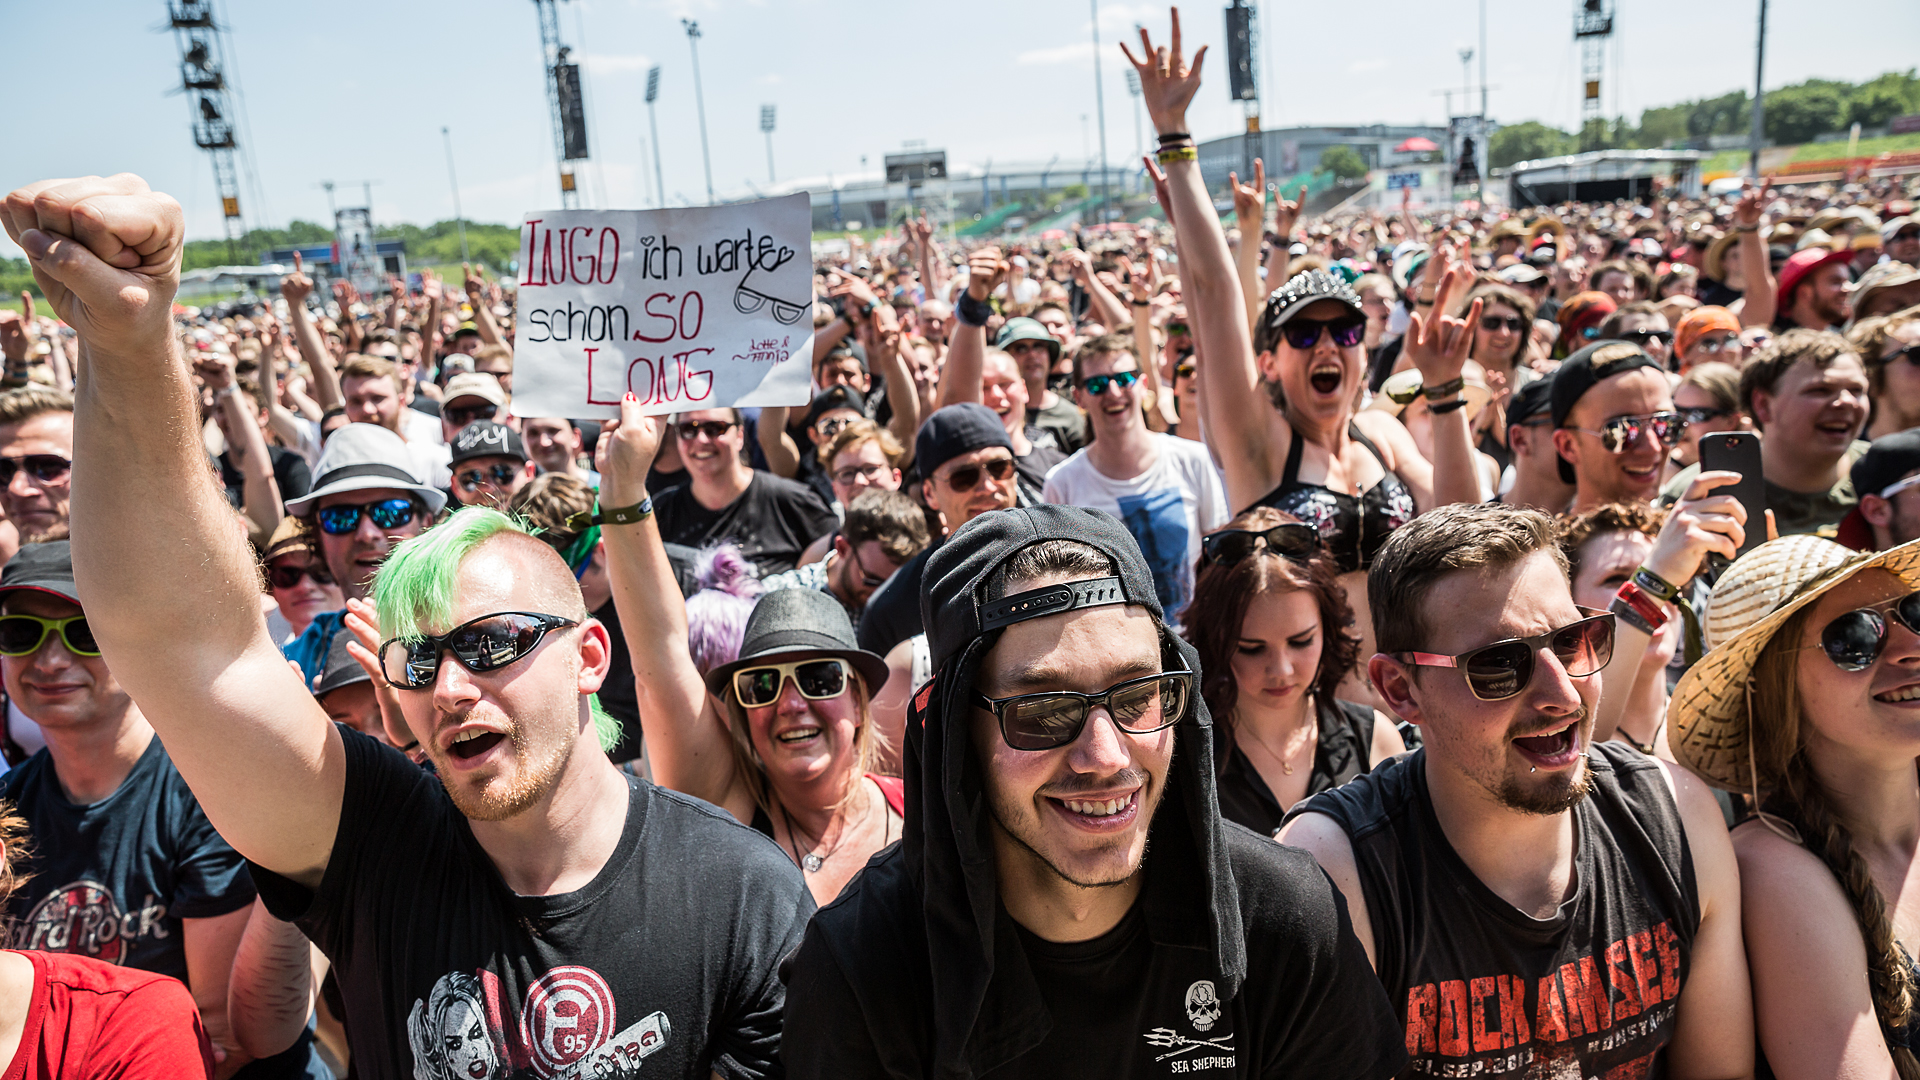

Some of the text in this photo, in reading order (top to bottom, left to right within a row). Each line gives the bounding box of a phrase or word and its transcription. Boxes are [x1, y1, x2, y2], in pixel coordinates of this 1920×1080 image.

[520, 219, 778, 287] INGO ich warte
[528, 290, 704, 344] schon SO
[584, 347, 715, 406] LONG
[563, 1034, 588, 1054] 95
[1405, 974, 1531, 1058] ROCK
[1171, 1060, 1190, 1074] SEA
